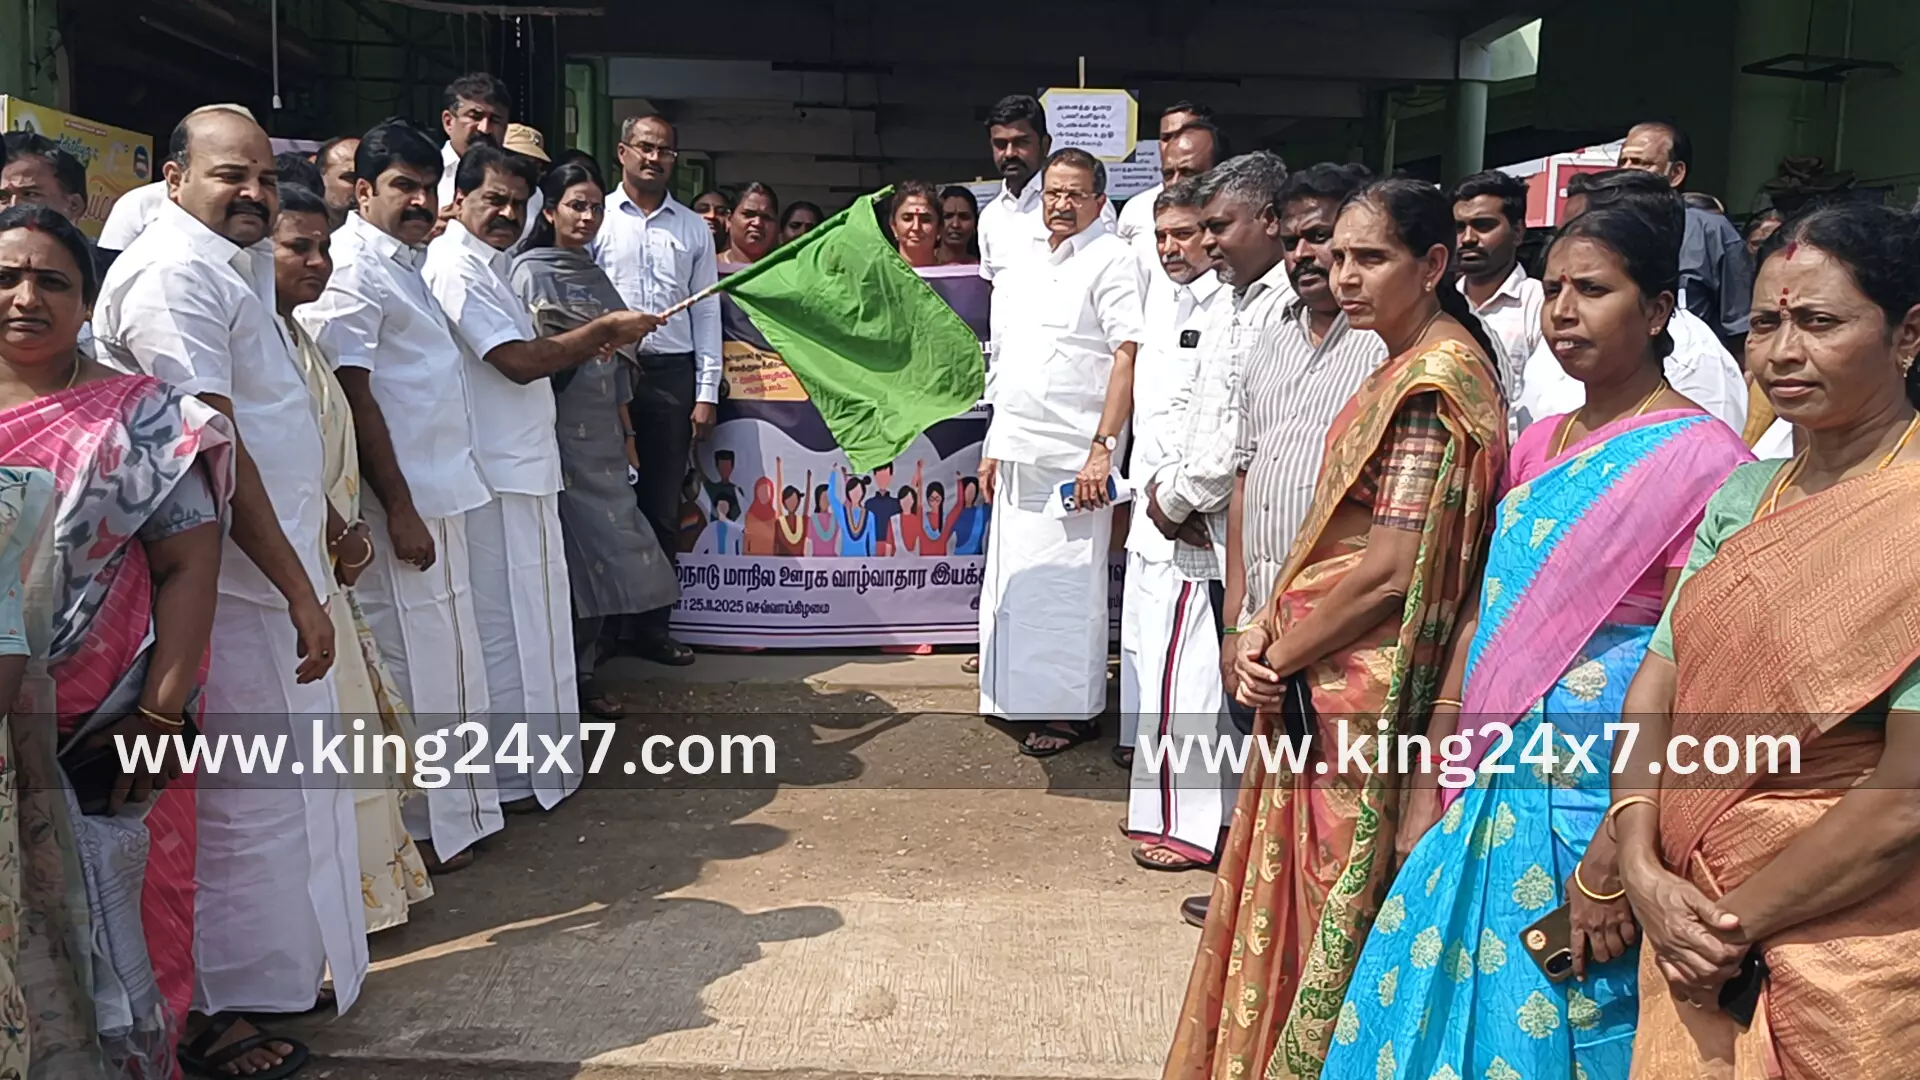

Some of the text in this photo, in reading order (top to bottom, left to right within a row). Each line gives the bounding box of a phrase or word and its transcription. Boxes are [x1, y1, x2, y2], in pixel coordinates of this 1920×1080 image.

[723, 563, 776, 594] மாநில
[779, 566, 829, 592] ஊரக
[831, 564, 928, 595] வாழ்வாதார
